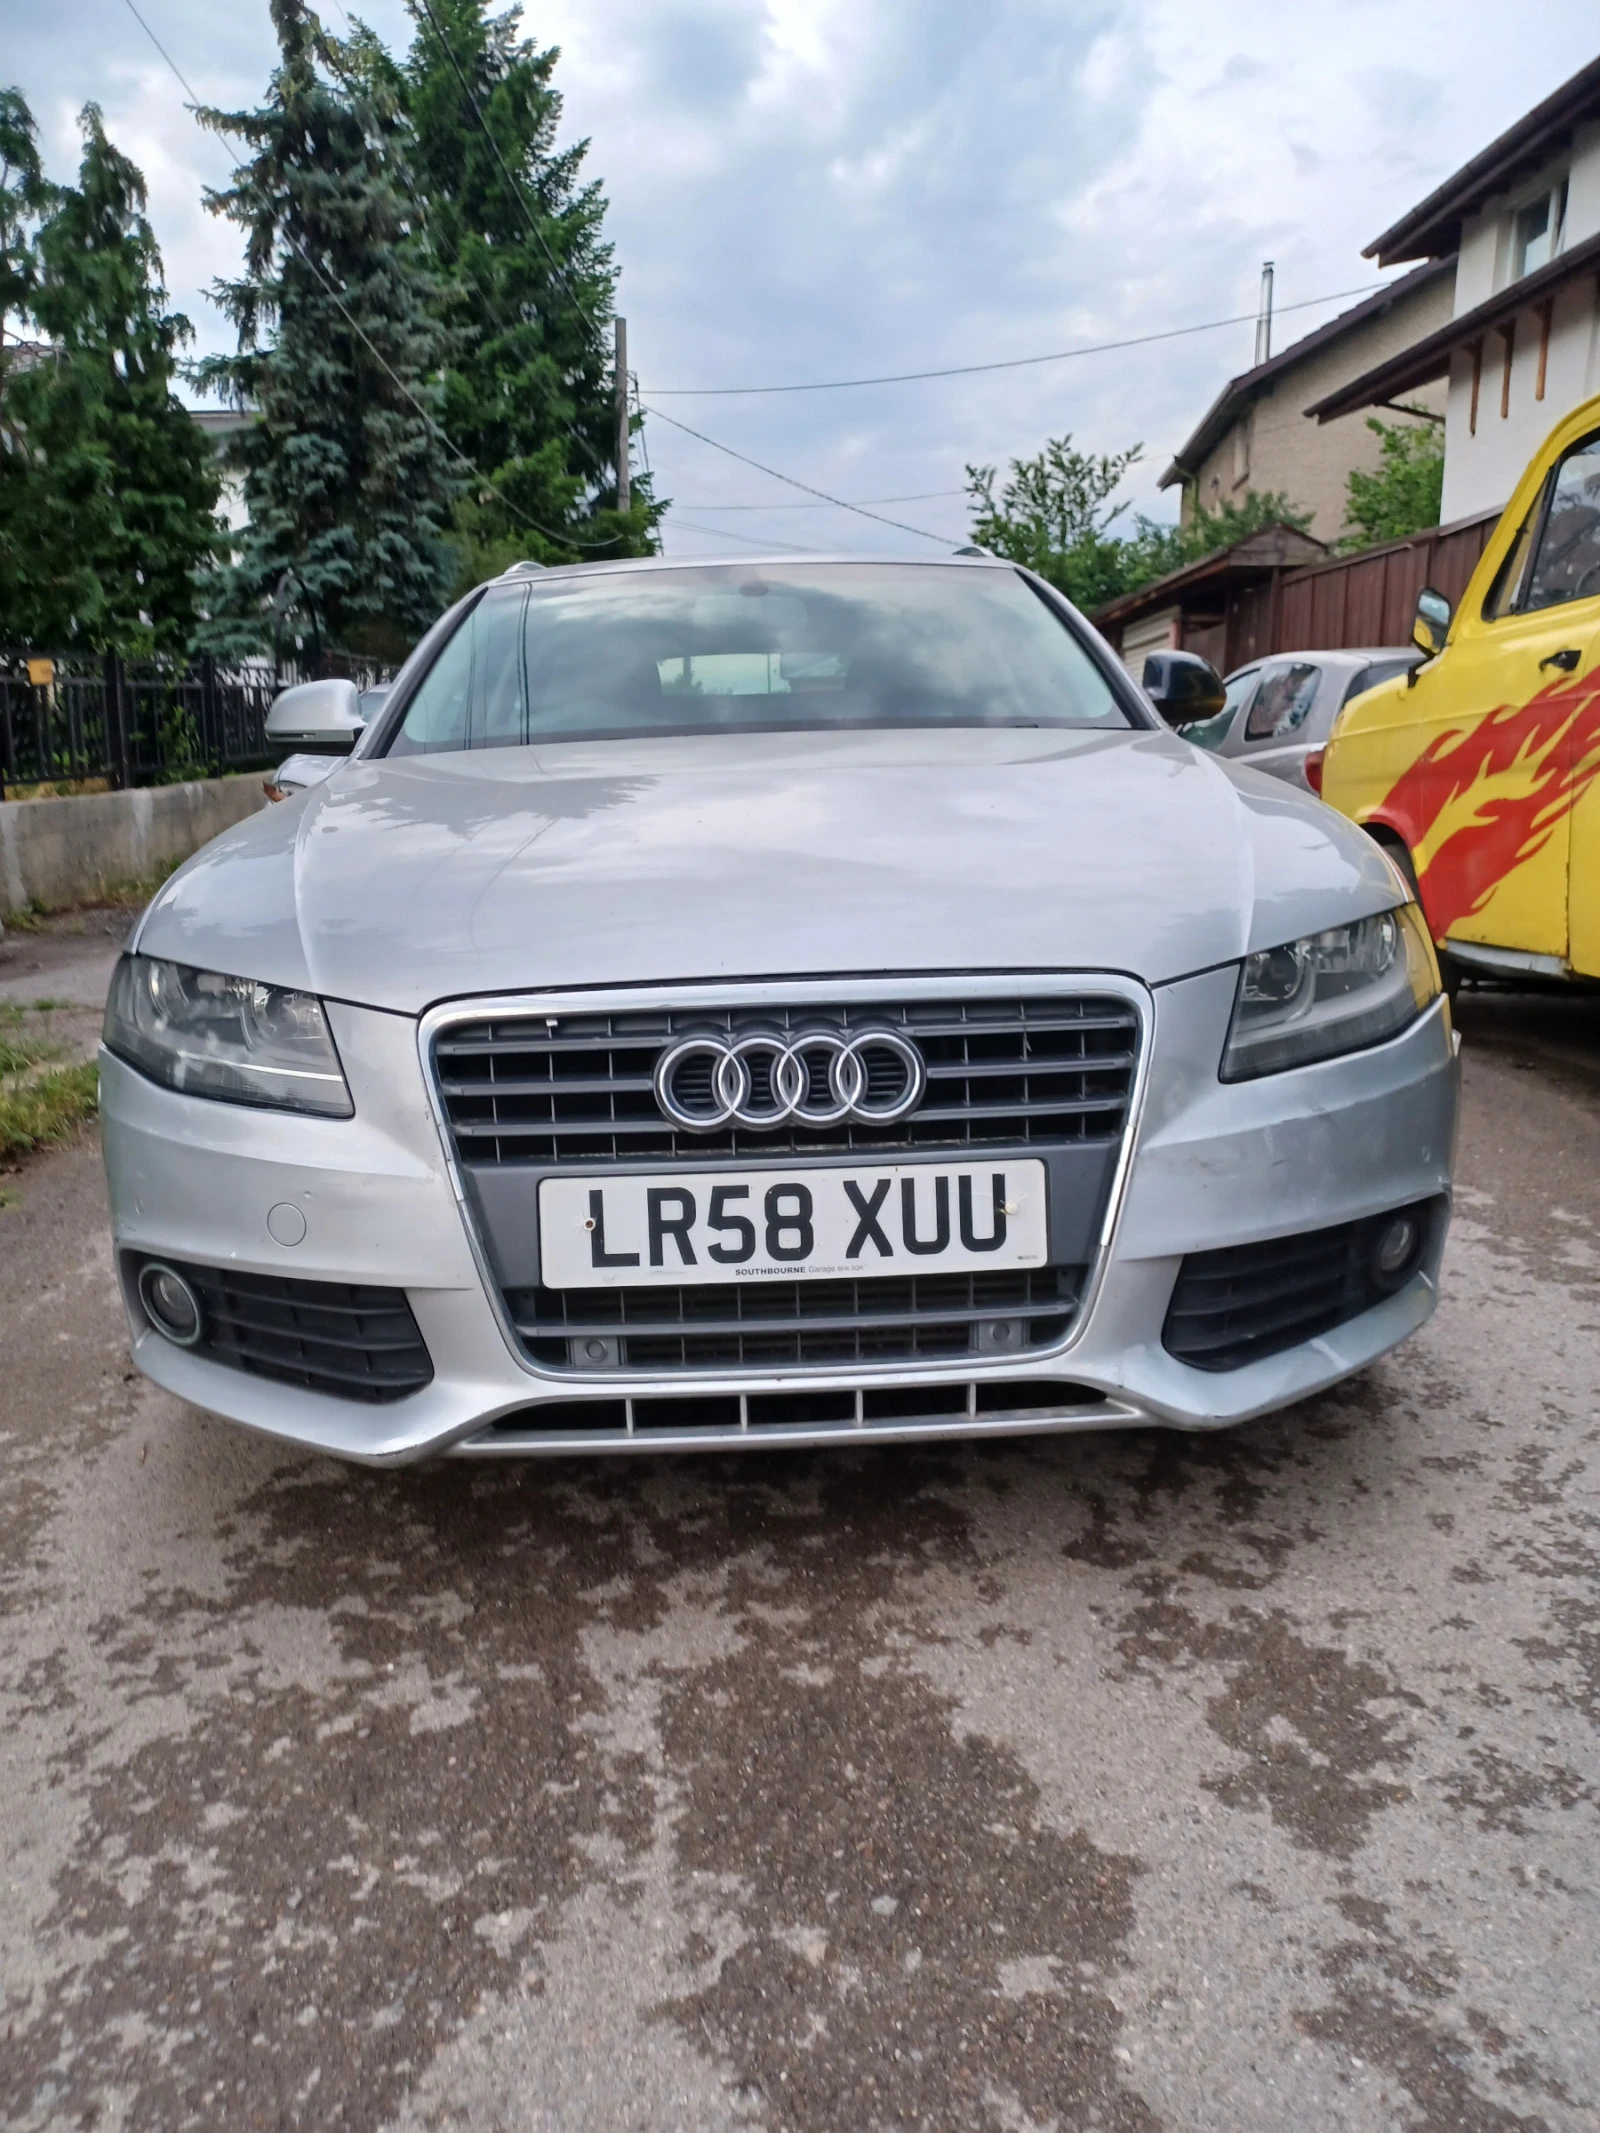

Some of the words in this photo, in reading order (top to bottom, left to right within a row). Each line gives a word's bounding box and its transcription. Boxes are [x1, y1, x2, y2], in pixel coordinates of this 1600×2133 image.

[589, 1182, 814, 1268] LR58
[842, 1173, 1007, 1259] XUU
[735, 1265, 806, 1276] SOUTHBOURNE
[808, 1265, 836, 1274] Garage
